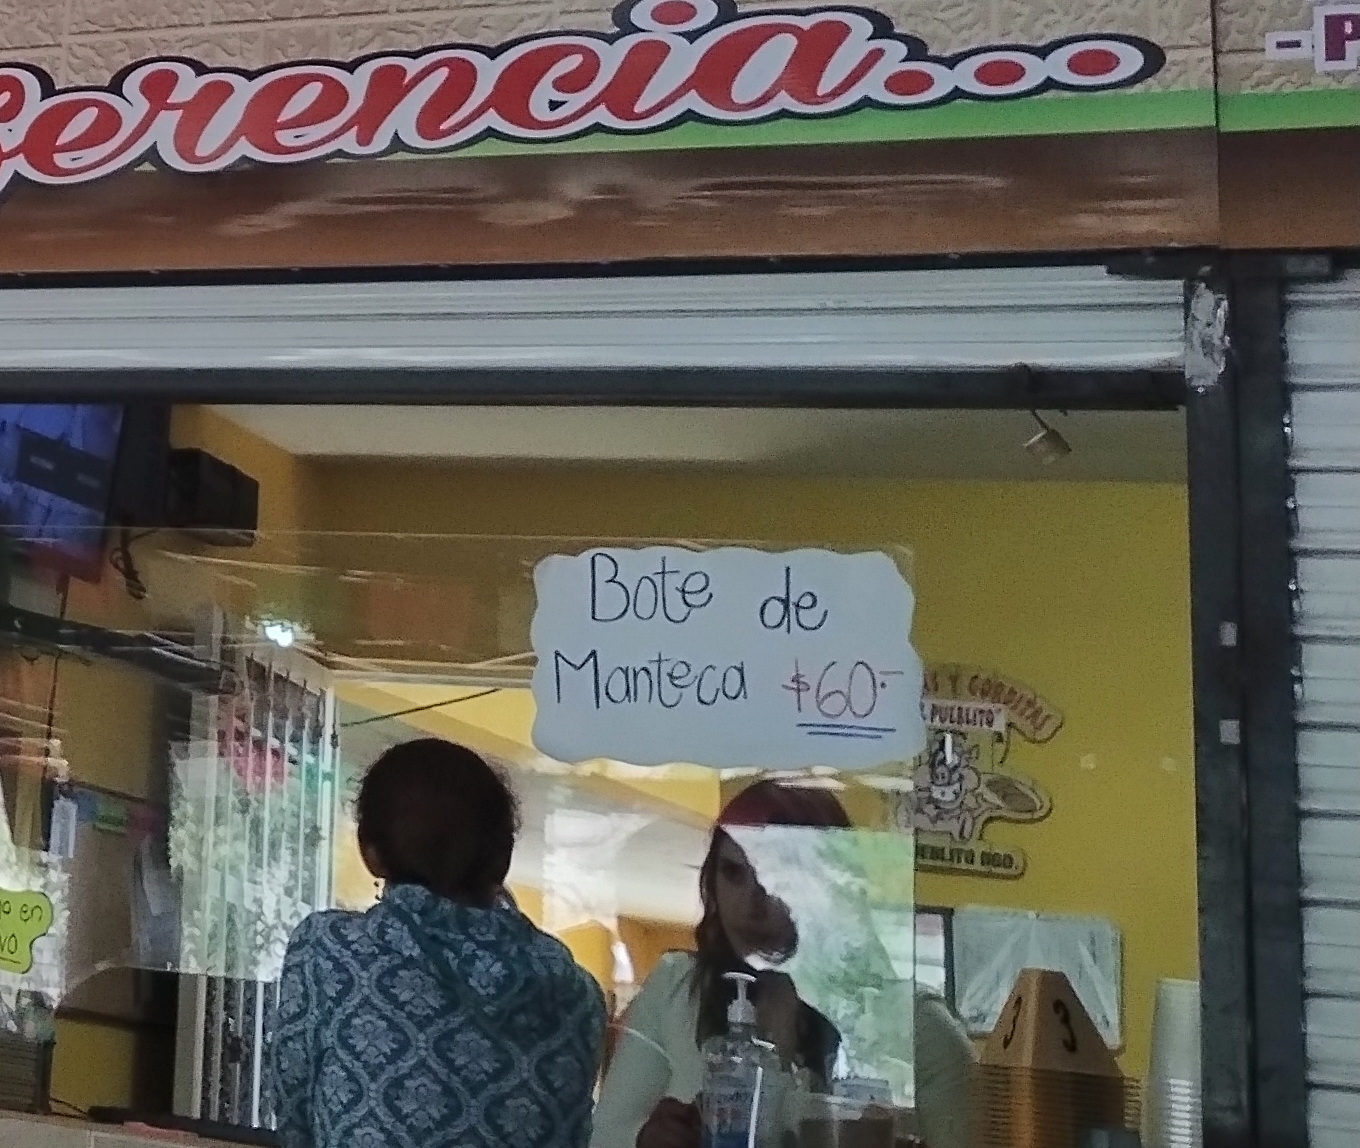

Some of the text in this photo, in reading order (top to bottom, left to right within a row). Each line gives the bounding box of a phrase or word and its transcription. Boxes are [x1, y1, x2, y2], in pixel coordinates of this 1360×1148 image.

[588, 551, 830, 634] Bote de
[553, 649, 749, 710] Manteca
[19, 903, 43, 923] en
[1052, 998, 1078, 1054] 3
